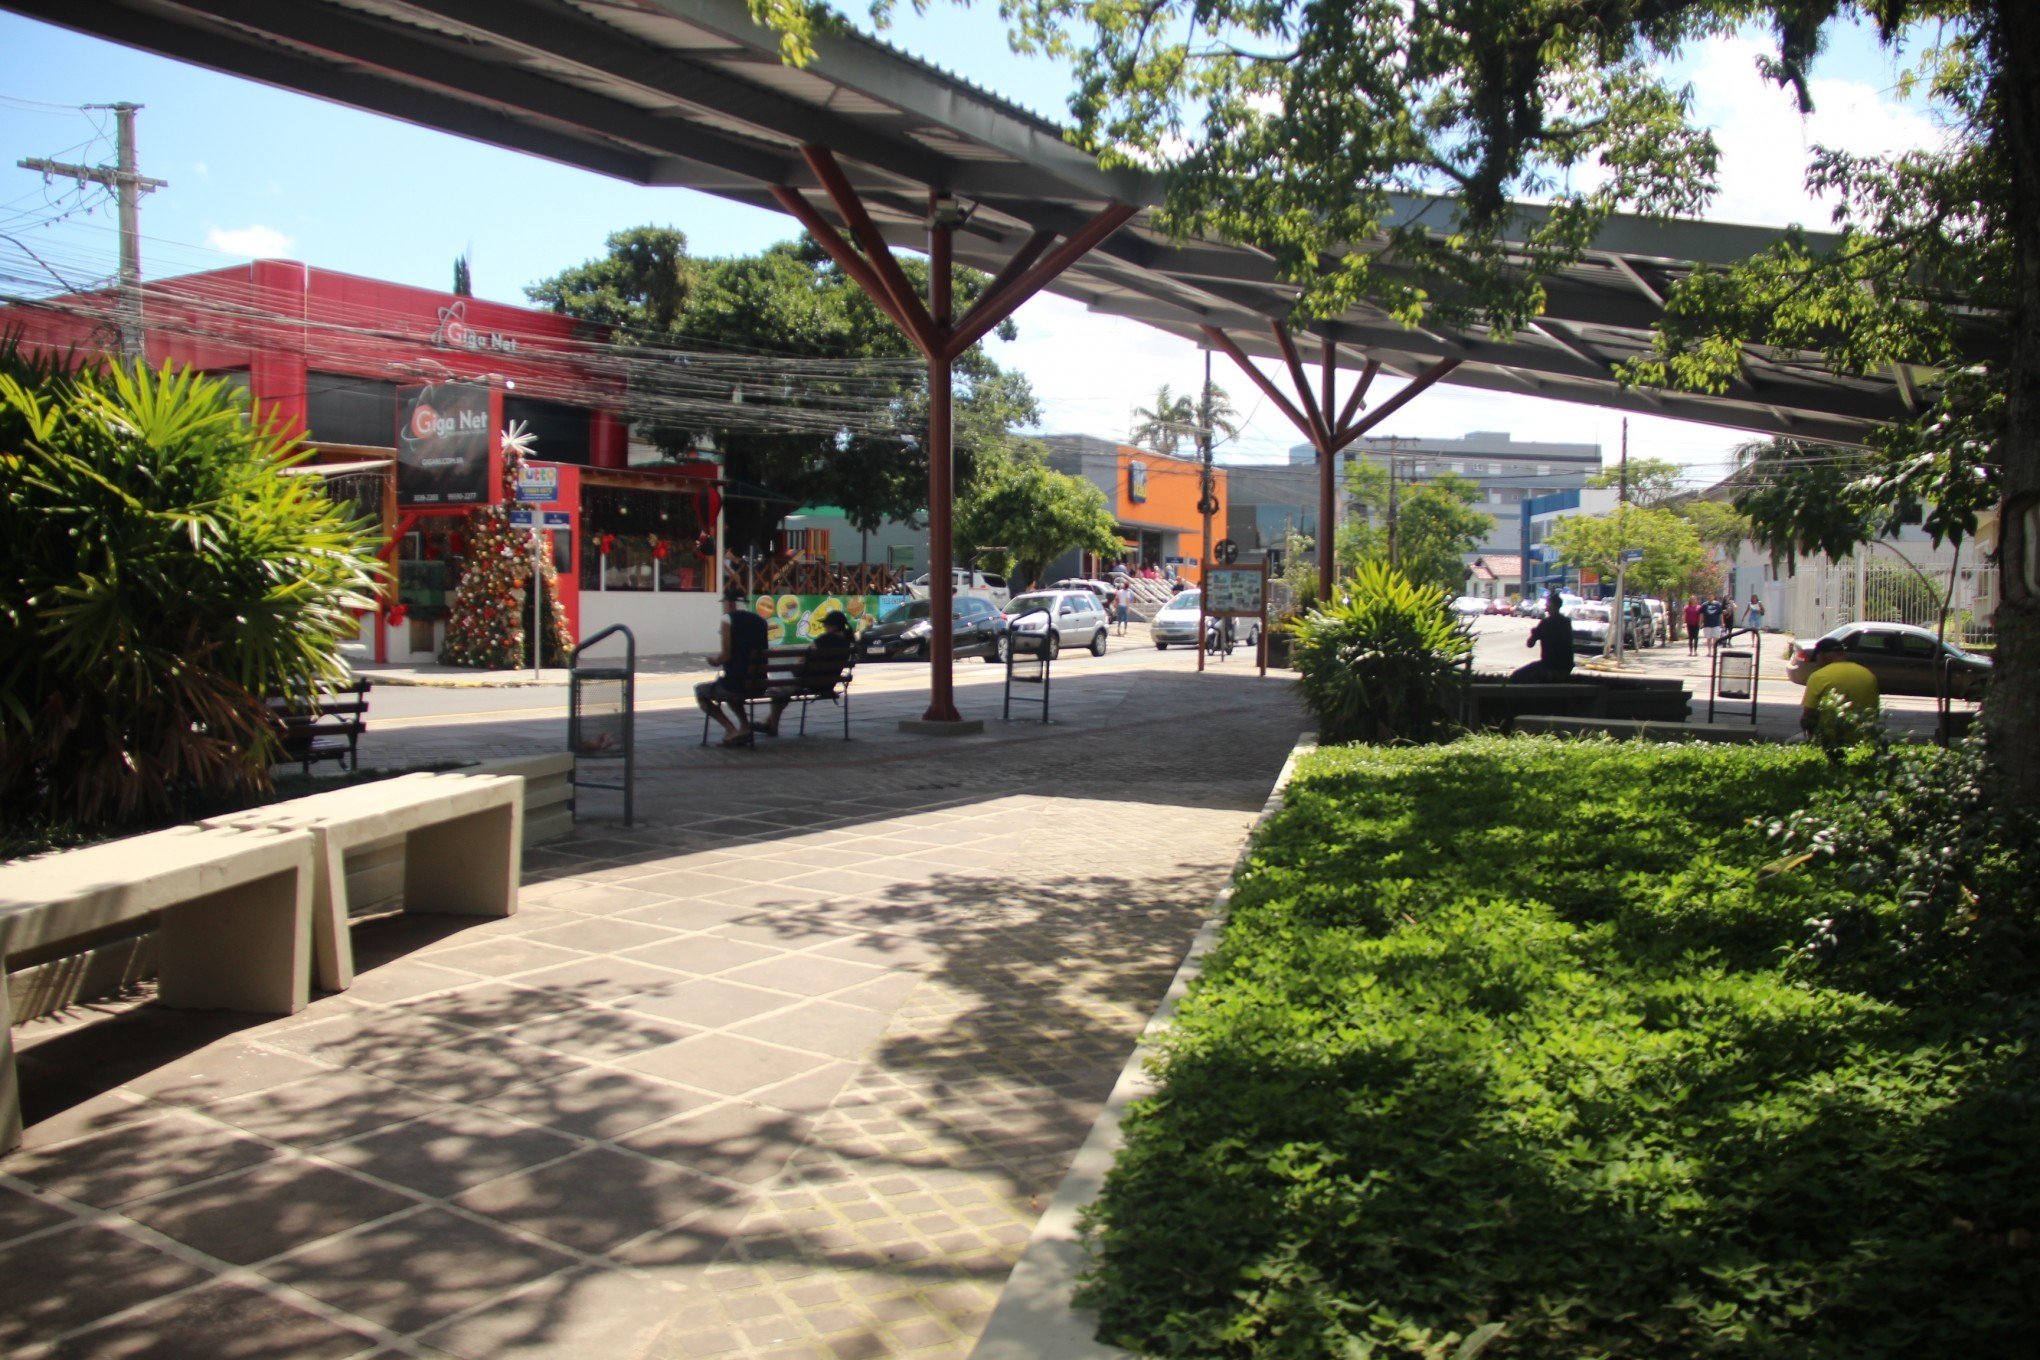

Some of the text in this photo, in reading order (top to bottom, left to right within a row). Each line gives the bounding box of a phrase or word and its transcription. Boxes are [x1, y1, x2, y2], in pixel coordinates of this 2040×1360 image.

[447, 322, 518, 351] Giga Net
[416, 409, 487, 436] Giga Net
